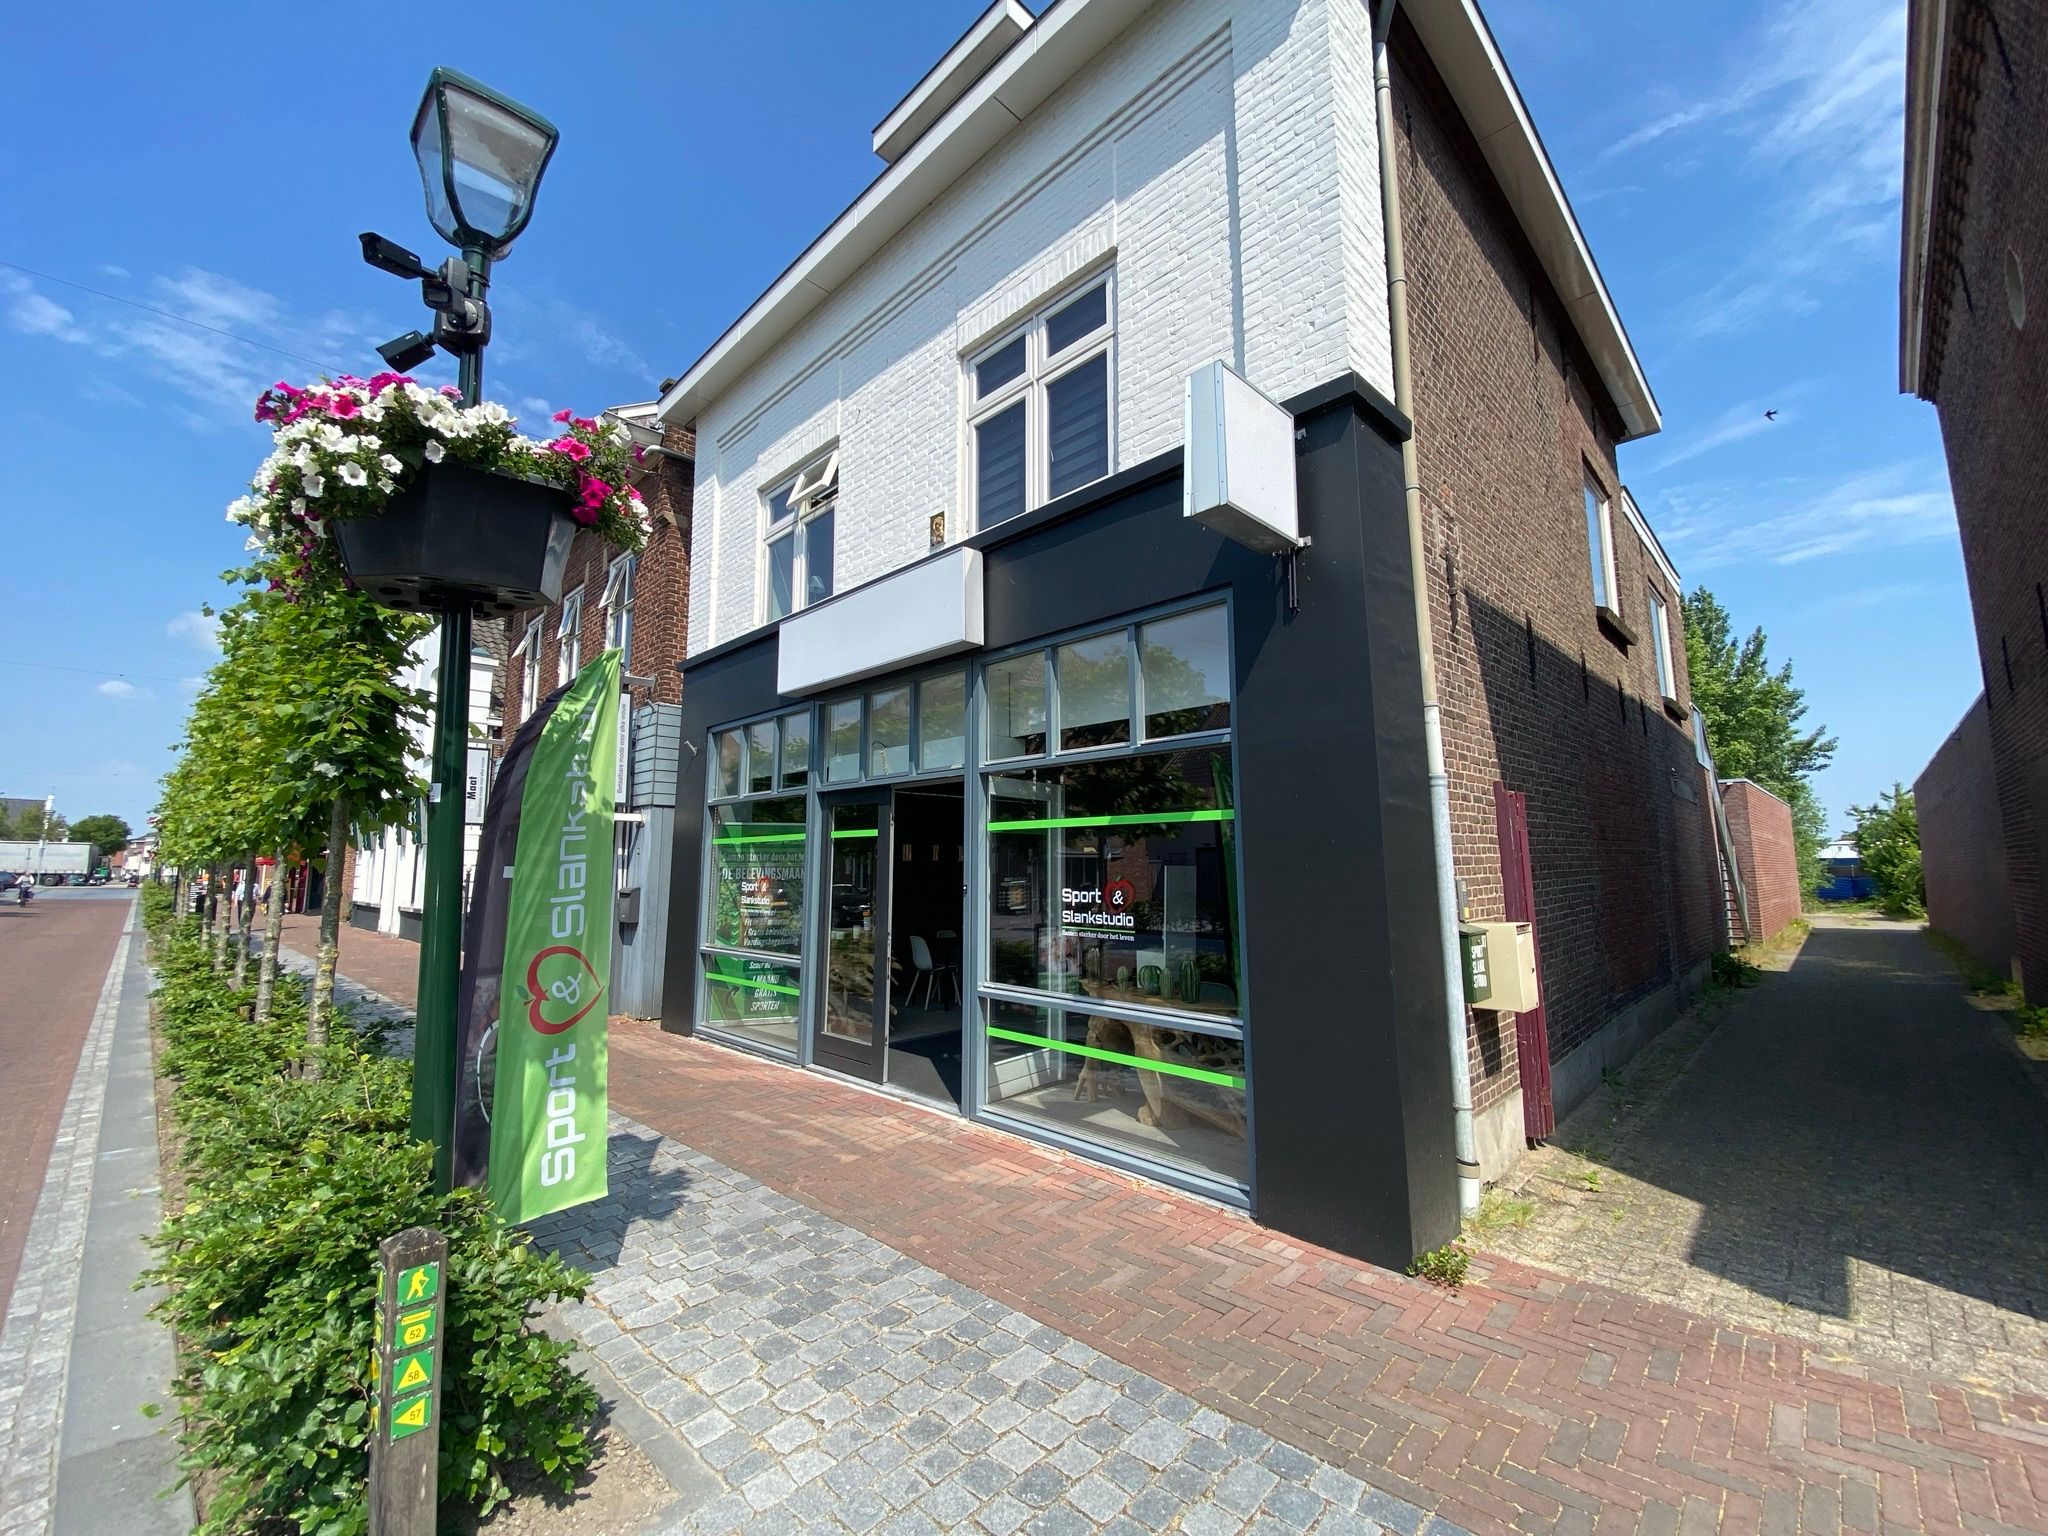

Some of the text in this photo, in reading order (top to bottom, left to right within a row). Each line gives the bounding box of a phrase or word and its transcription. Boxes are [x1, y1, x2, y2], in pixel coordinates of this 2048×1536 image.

[466, 776, 477, 800] Maat
[722, 868, 733, 880] DE
[741, 882, 759, 893] Sport
[1061, 887, 1124, 907] Sport &
[1061, 909, 1135, 927] Slankstudio
[1061, 929, 1079, 937] Samen
[1079, 931, 1097, 939] sterker
[1120, 933, 1135, 942] leven
[551, 972, 582, 1005] &
[541, 1043, 586, 1187] Sport
[409, 1328, 422, 1340] 52
[408, 1370, 420, 1382] 58
[410, 1408, 422, 1421] 57
